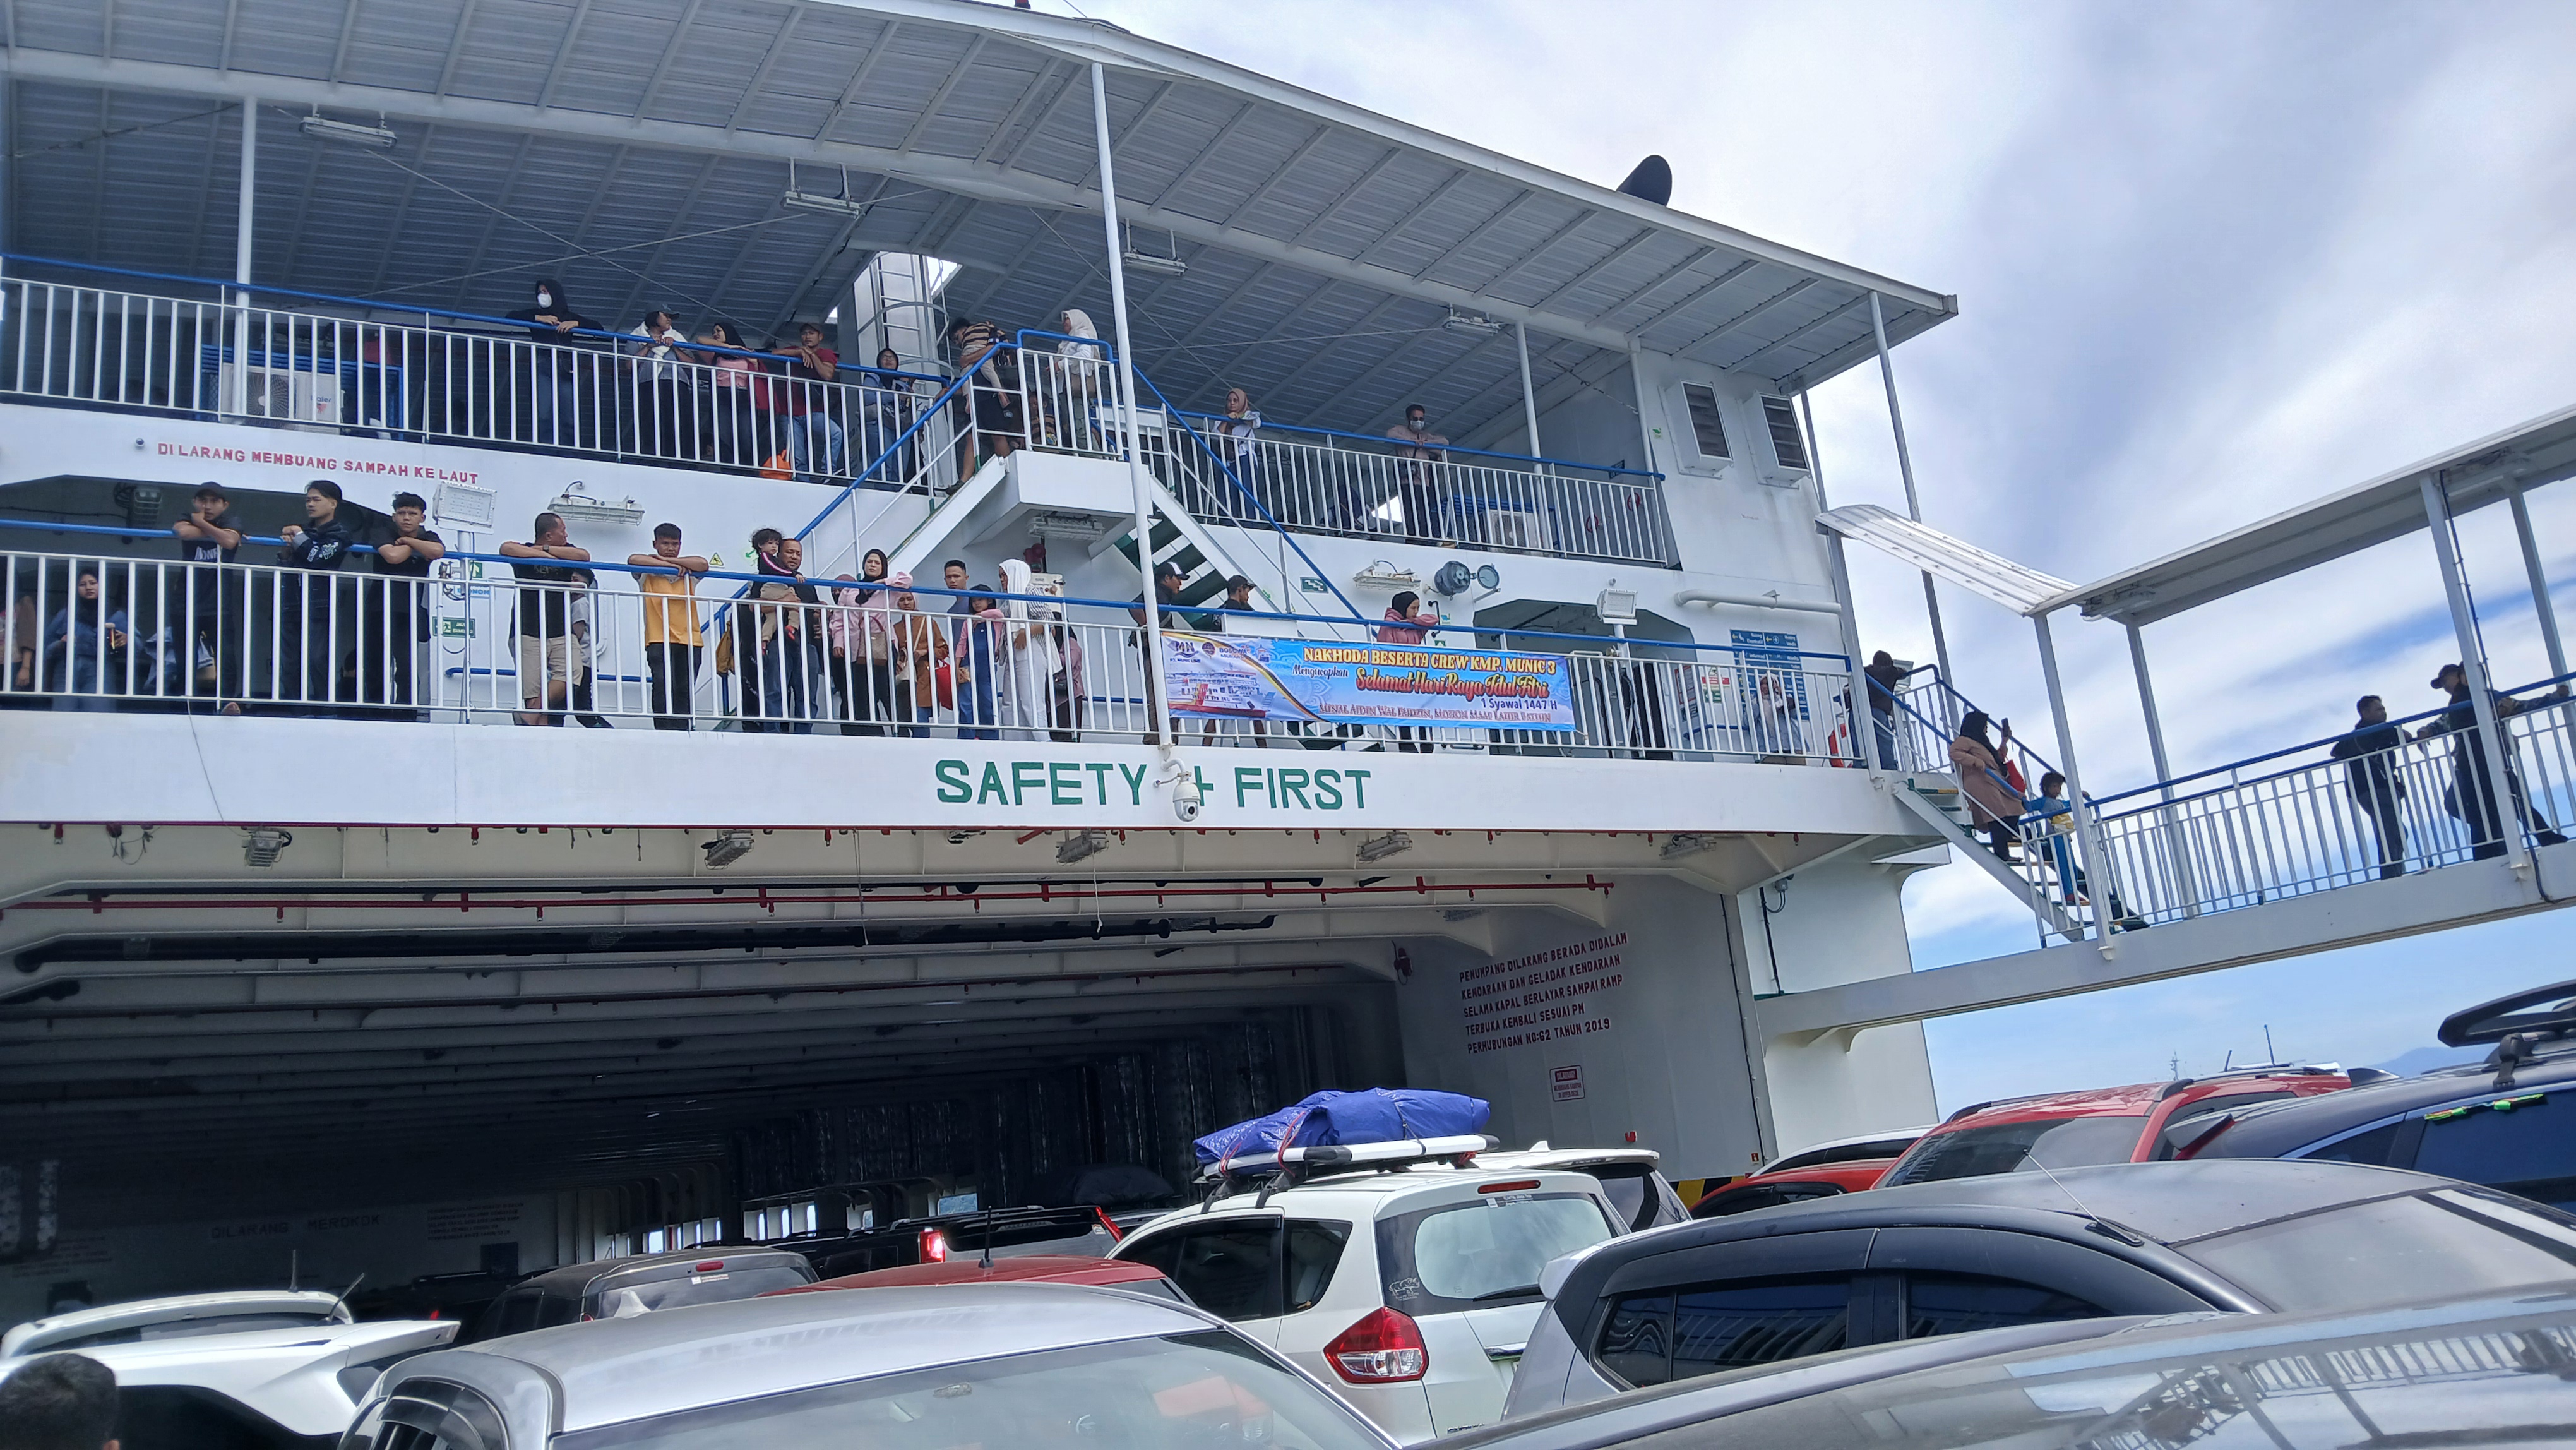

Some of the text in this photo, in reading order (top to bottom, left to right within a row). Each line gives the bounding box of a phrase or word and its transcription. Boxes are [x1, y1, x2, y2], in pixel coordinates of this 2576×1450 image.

[251, 450, 337, 470] MEMBUANG
[343, 460, 408, 477] SAMPAH
[414, 467, 434, 478] KE
[439, 469, 478, 484] LAUT
[1292, 664, 1349, 679] Mengucapkan
[1303, 647, 1556, 674] NAKHODA BESERTA CREW KMP. MUNIC 3
[1356, 667, 1550, 702] Selamat Hari Raya Idul Fitri
[1481, 698, 1558, 711] 1 Syawal 1447 H
[935, 760, 1371, 810] SAFETY FIRST
[1459, 932, 1628, 983] PENUMPANG DILARANG BERADA DIDALAM
[1461, 953, 1621, 1000] KENDARAAN DAN GELADAK KENDARAAN
[1463, 974, 1623, 1017] SELAMA KAPAL BERLAYAR SAMPAI RAMP
[1465, 1002, 1585, 1036] TERBUKA KEMBALI SESUAI PM
[1467, 1017, 1611, 1055] PERHUBUNGAN NO:62 TAHUN 2019
[210, 1214, 381, 1239] DILARANG MEROKOK
